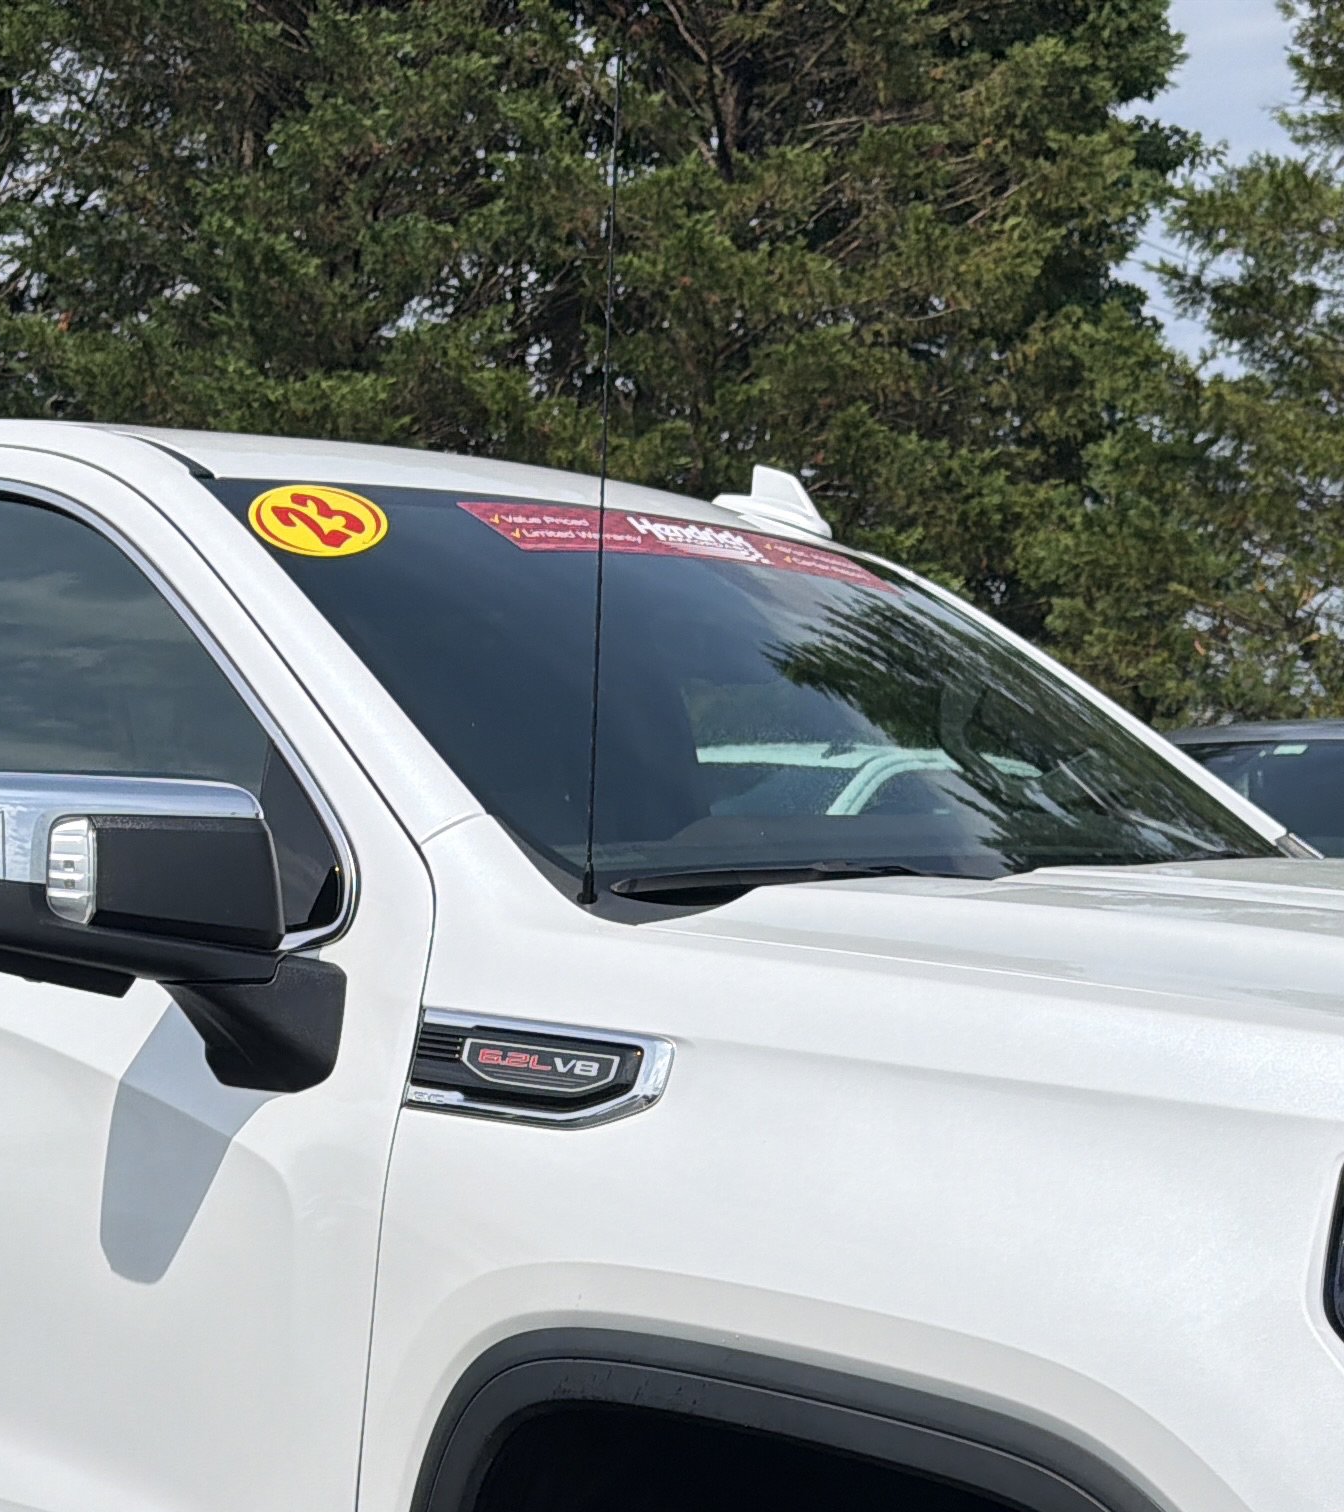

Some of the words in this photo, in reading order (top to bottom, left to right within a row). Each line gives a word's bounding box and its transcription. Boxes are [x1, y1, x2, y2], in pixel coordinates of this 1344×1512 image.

[271, 493, 365, 549] 23
[500, 514, 542, 524] Value
[543, 515, 590, 527] Priced
[576, 531, 641, 545] Waranty
[627, 516, 760, 556] Hendrick
[478, 1048, 552, 1071] 6.2L
[554, 1057, 599, 1077] V8
